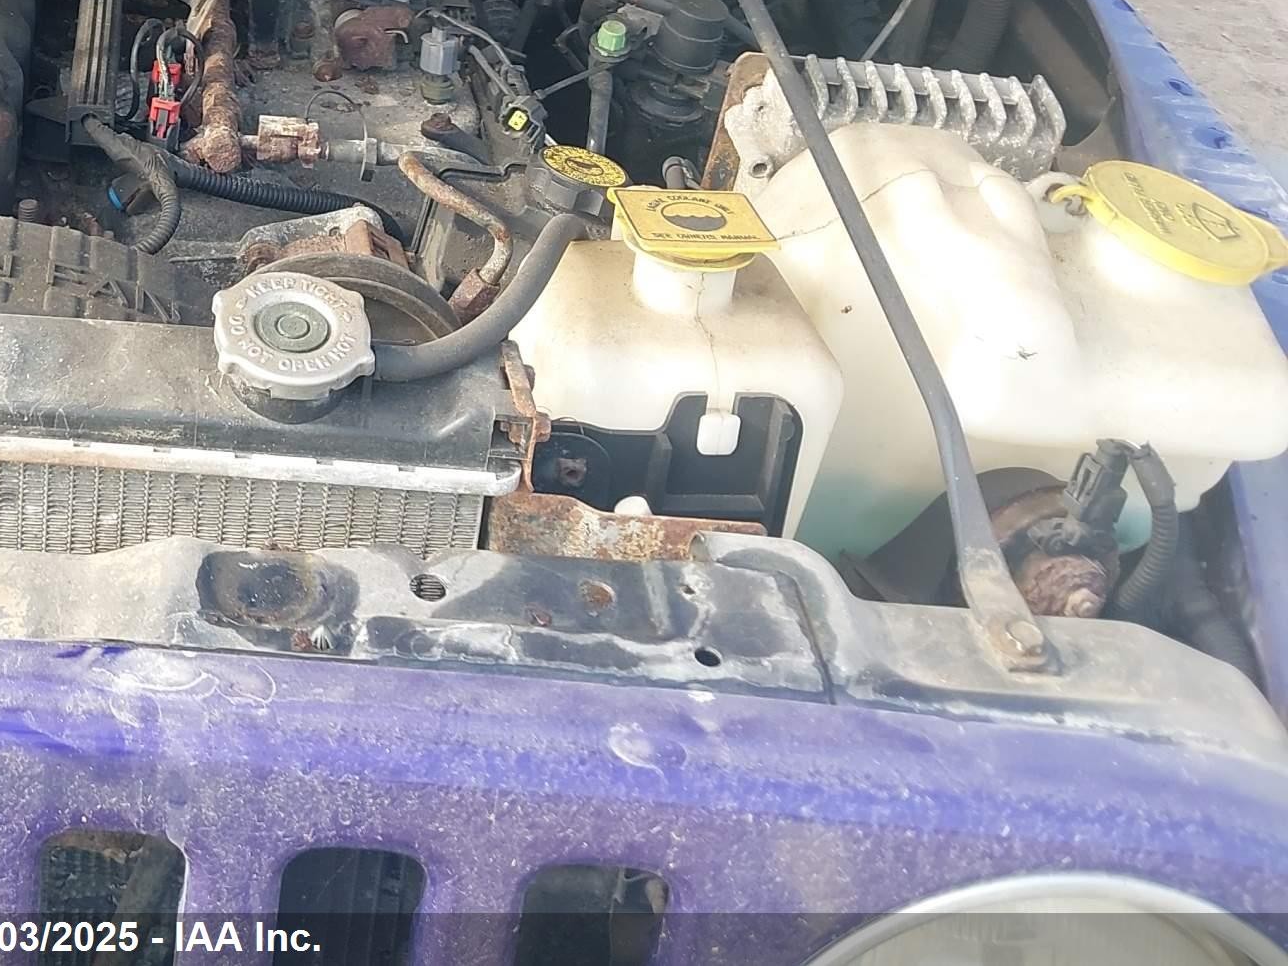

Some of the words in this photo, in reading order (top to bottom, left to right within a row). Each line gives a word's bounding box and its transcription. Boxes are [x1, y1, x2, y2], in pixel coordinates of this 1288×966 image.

[667, 195, 714, 205] COOLANT
[46, 263, 182, 323] FAN
[245, 277, 297, 299] KEEP
[302, 279, 349, 309] TIGHT
[229, 315, 247, 335] DO
[238, 339, 274, 364] NOT
[278, 354, 331, 372] OPEN
[328, 333, 358, 363] HOT
